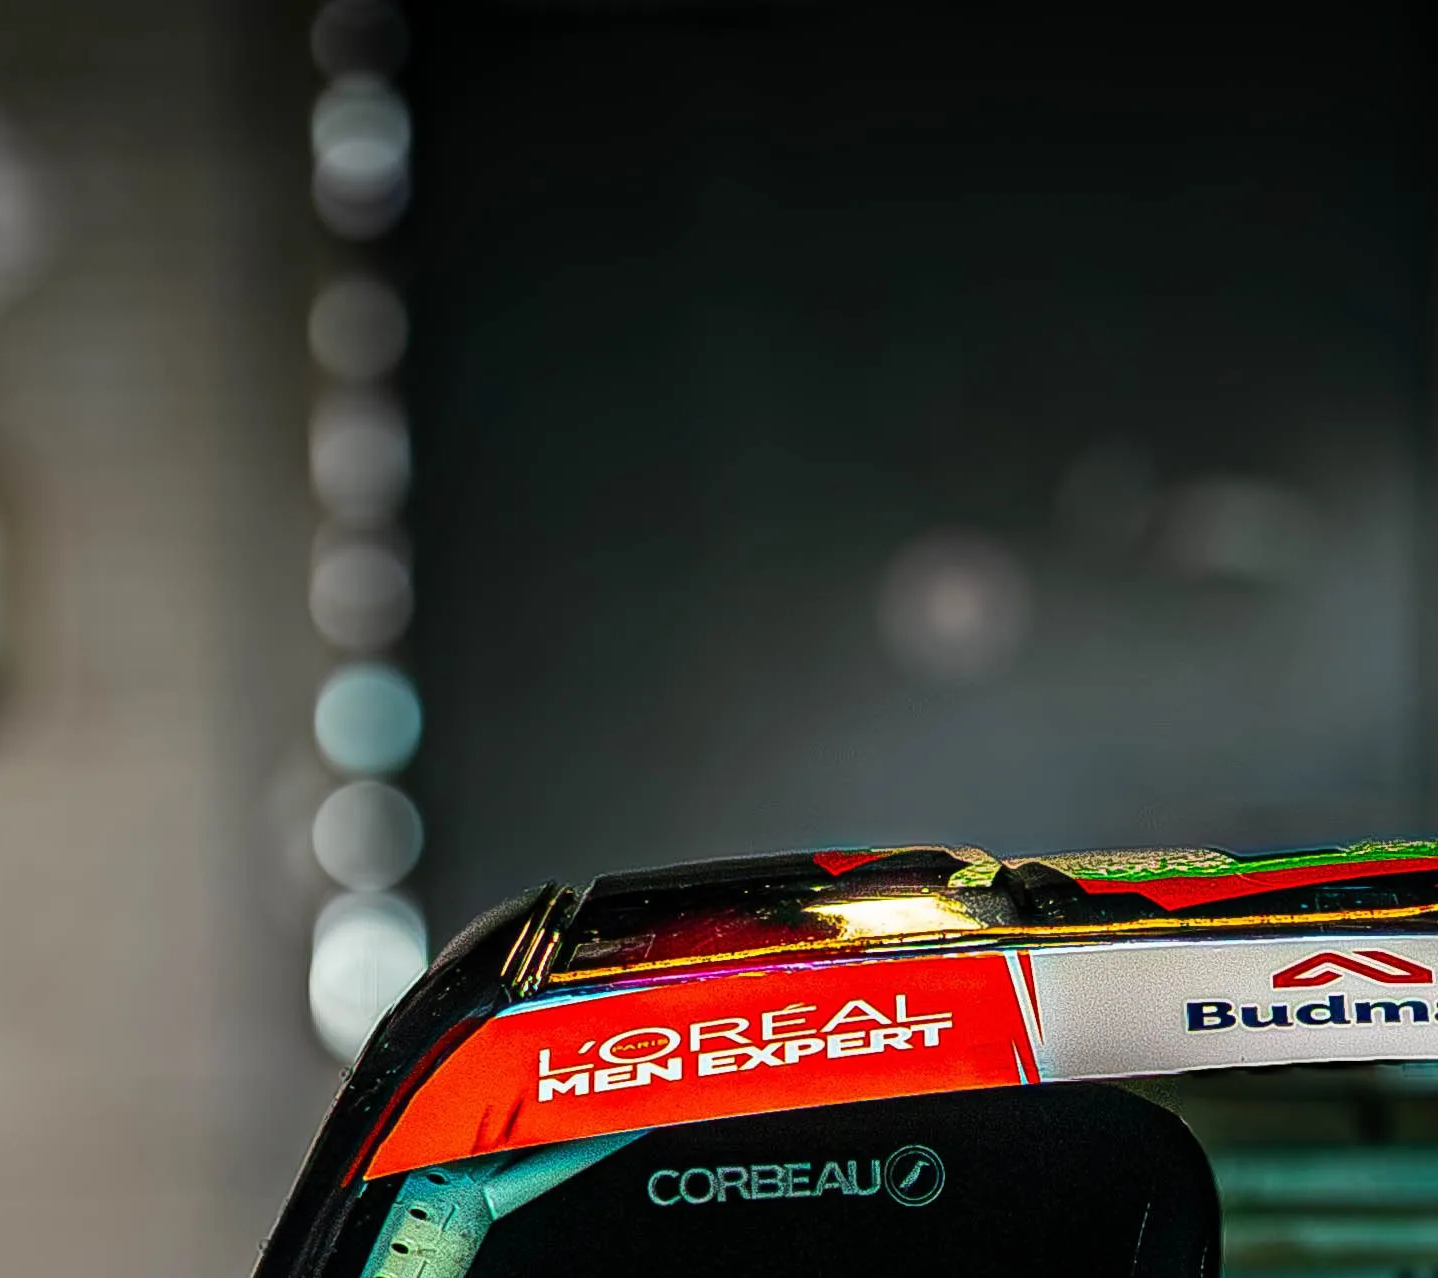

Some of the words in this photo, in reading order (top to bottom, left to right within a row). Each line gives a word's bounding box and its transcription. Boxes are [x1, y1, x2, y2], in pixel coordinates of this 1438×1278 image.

[538, 1056, 683, 1102] MEN
[698, 1020, 953, 1076] EXPERT
[647, 1159, 882, 1207] CORBEAU
